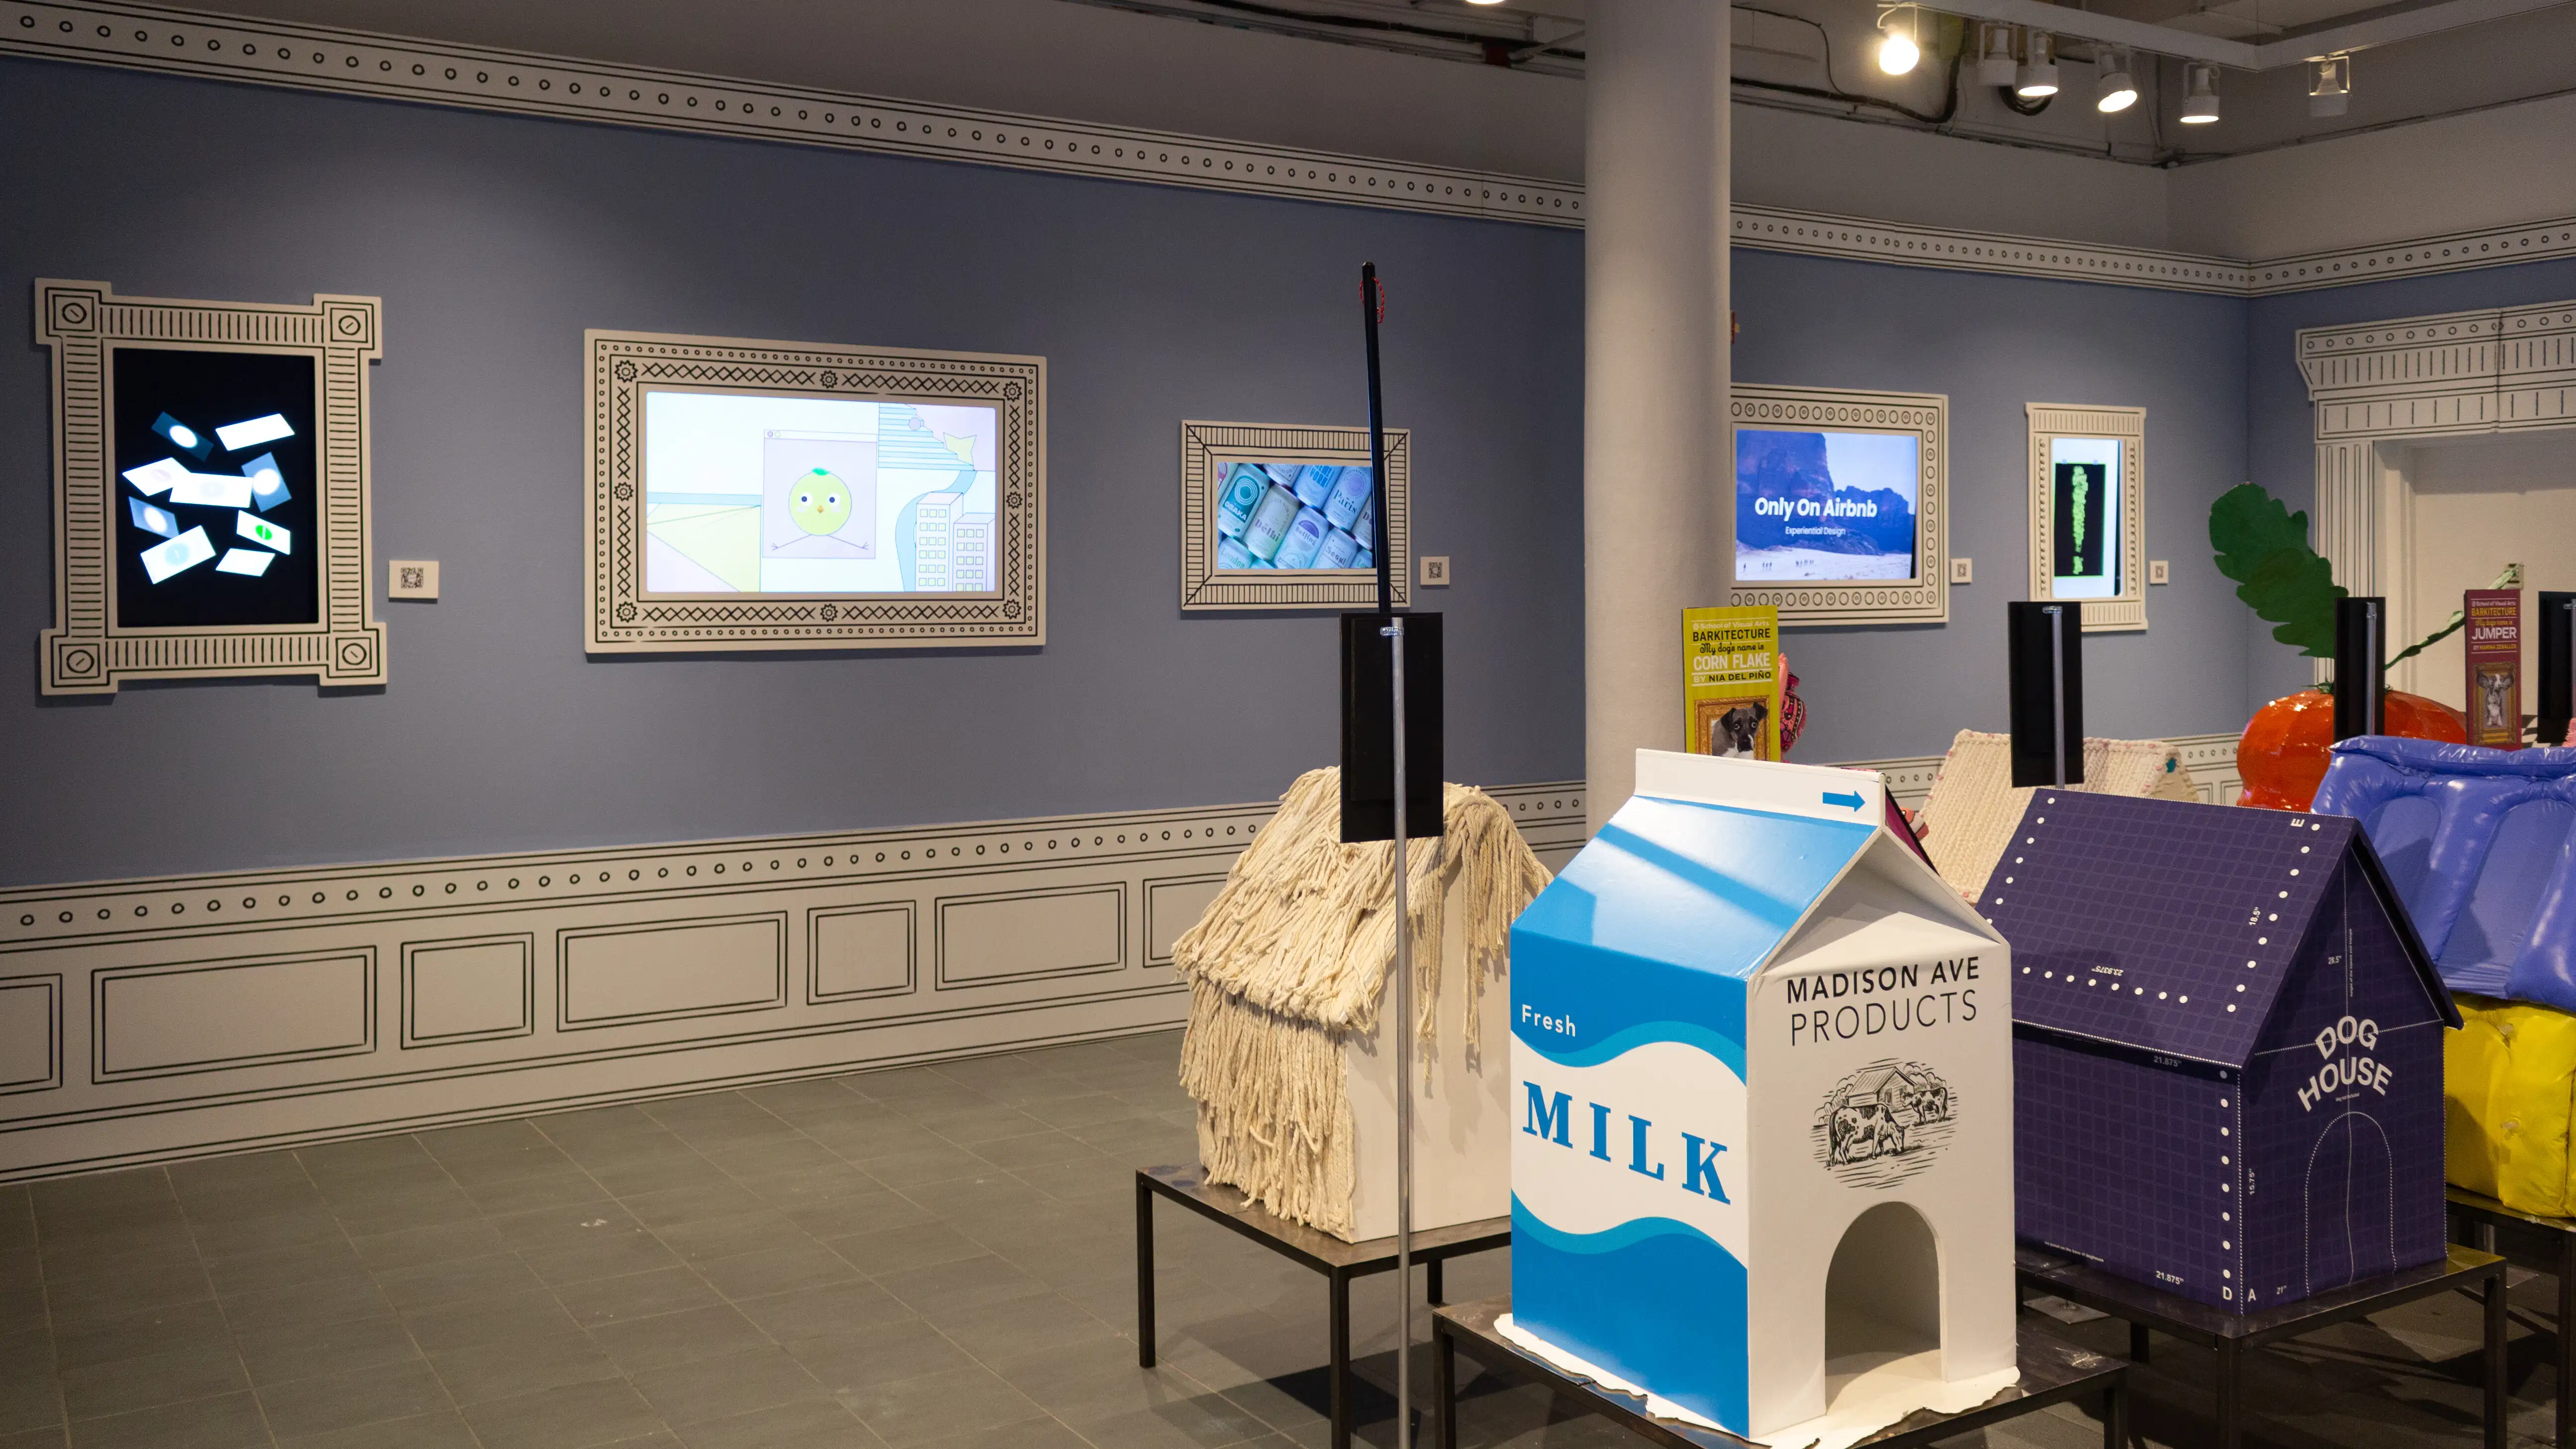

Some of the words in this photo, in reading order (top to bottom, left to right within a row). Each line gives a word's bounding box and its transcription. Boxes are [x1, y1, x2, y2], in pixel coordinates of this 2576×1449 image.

[1334, 489, 1357, 514] Paris
[1755, 497, 1794, 521] Only
[1797, 498, 1820, 516] On
[1823, 497, 1877, 517] Airbnb
[1295, 527, 1317, 546] Beijing
[1785, 526, 1823, 537] Experiential
[1823, 527, 1846, 537] Design
[1326, 547, 1346, 565] Seoul
[2472, 607, 2516, 616] BARKITECTURE
[1693, 628, 1771, 642] BARKITECTURE
[2472, 627, 2517, 640] JUMPER
[1700, 643, 1716, 655] My
[1718, 642, 1735, 654] dog's
[1693, 654, 1728, 670] CORN
[1733, 652, 1771, 668] FLAKE
[1749, 670, 1771, 679] PIÑO
[2290, 818, 2305, 827] E
[1787, 964, 1918, 1004] MADISON
[1931, 956, 1979, 984] AVE
[1522, 1004, 1576, 1037] Fresh
[1791, 989, 1976, 1046] PRODUCTS
[2315, 1016, 2378, 1059] DOG
[2298, 1057, 2393, 1112] HOUSE
[1523, 1080, 1731, 1205] MILK
[2223, 1286, 2232, 1300] D
[2248, 1288, 2256, 1302] A
